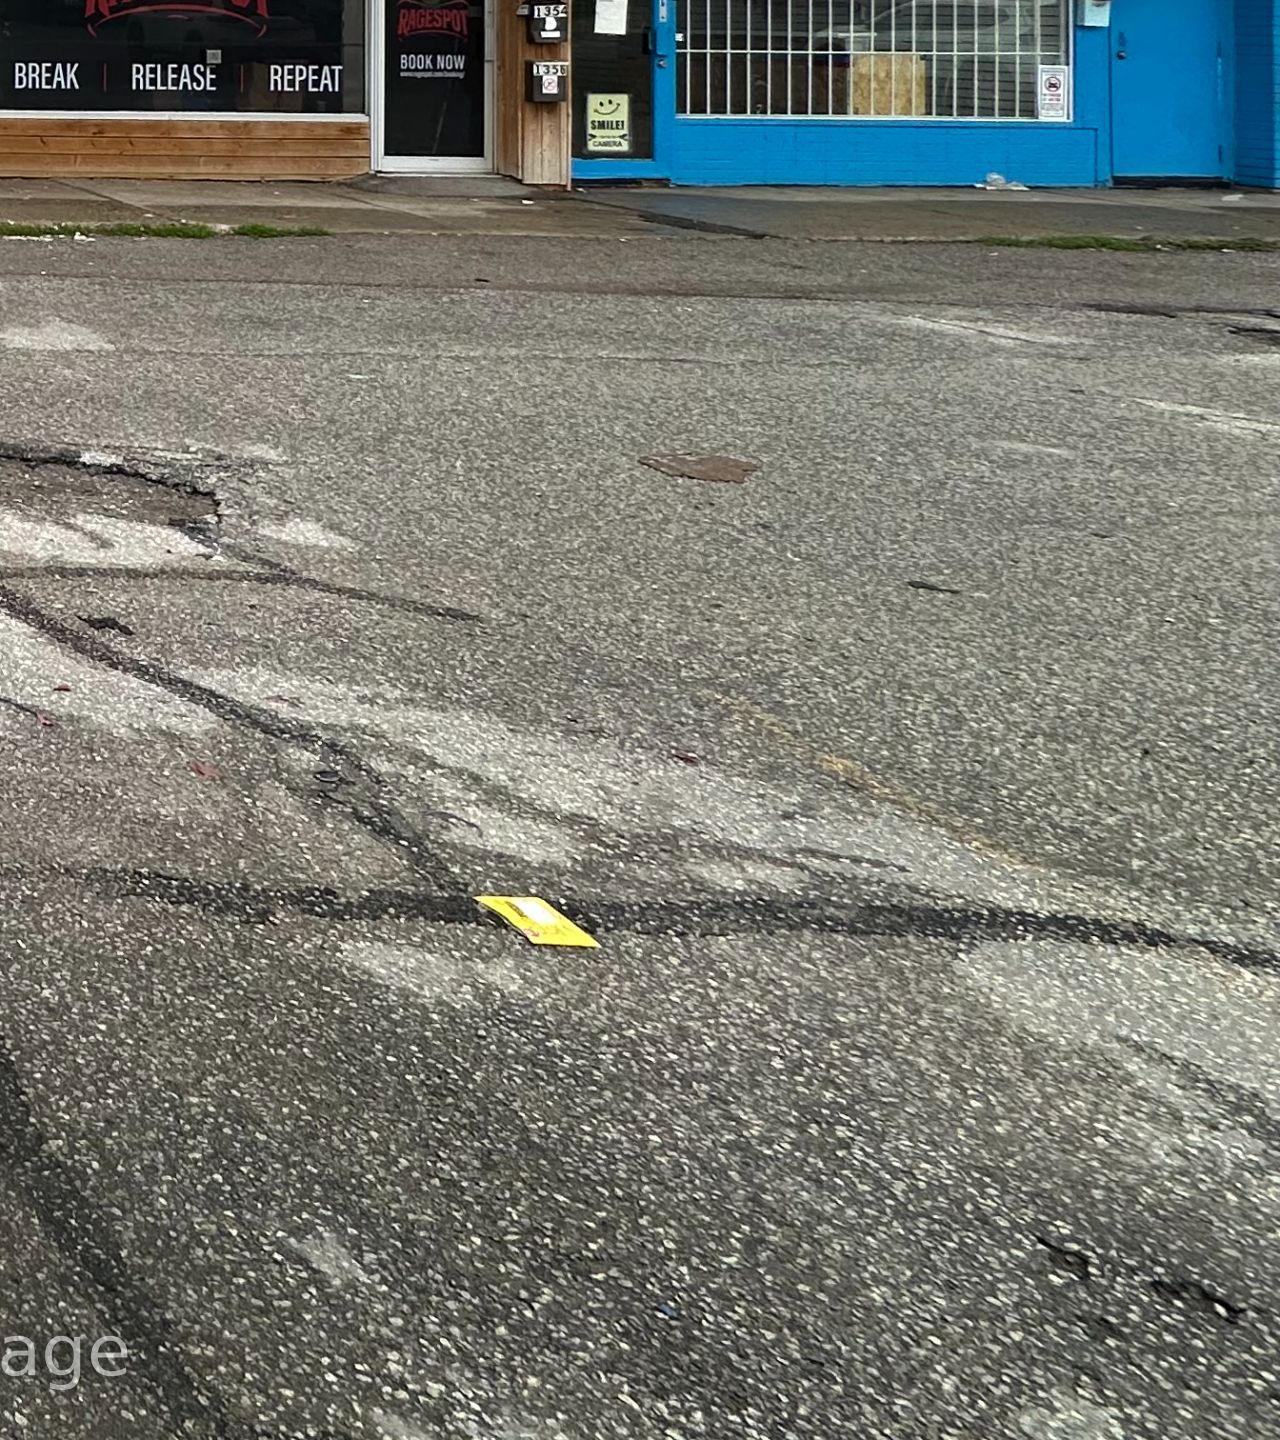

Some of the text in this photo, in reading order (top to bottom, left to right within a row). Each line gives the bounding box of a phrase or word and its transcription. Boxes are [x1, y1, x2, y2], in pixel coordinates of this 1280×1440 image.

[398, 8, 469, 36] RAGESPOT
[400, 54, 465, 70] BOOK NOW
[14, 62, 343, 92] BREAK RELEASE REPEAT
